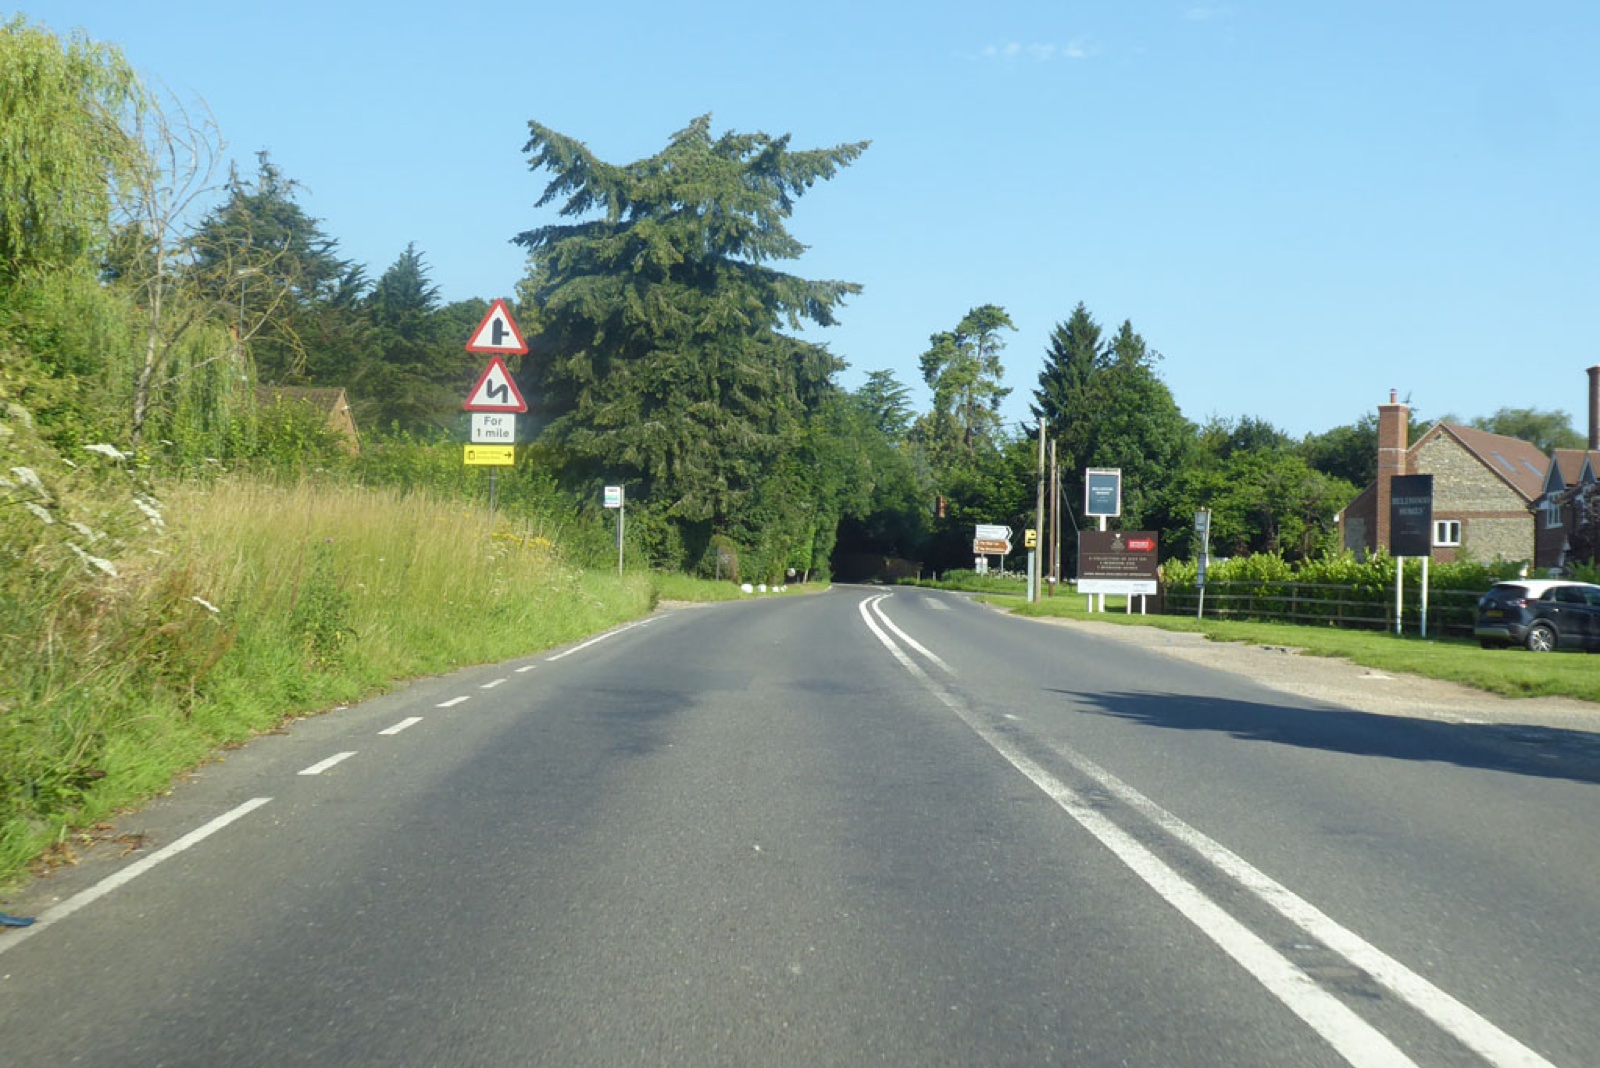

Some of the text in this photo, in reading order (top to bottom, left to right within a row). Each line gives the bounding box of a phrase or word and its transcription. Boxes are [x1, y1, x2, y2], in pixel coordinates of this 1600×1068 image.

[483, 416, 503, 426] For
[477, 428, 510, 438] 1 mile
